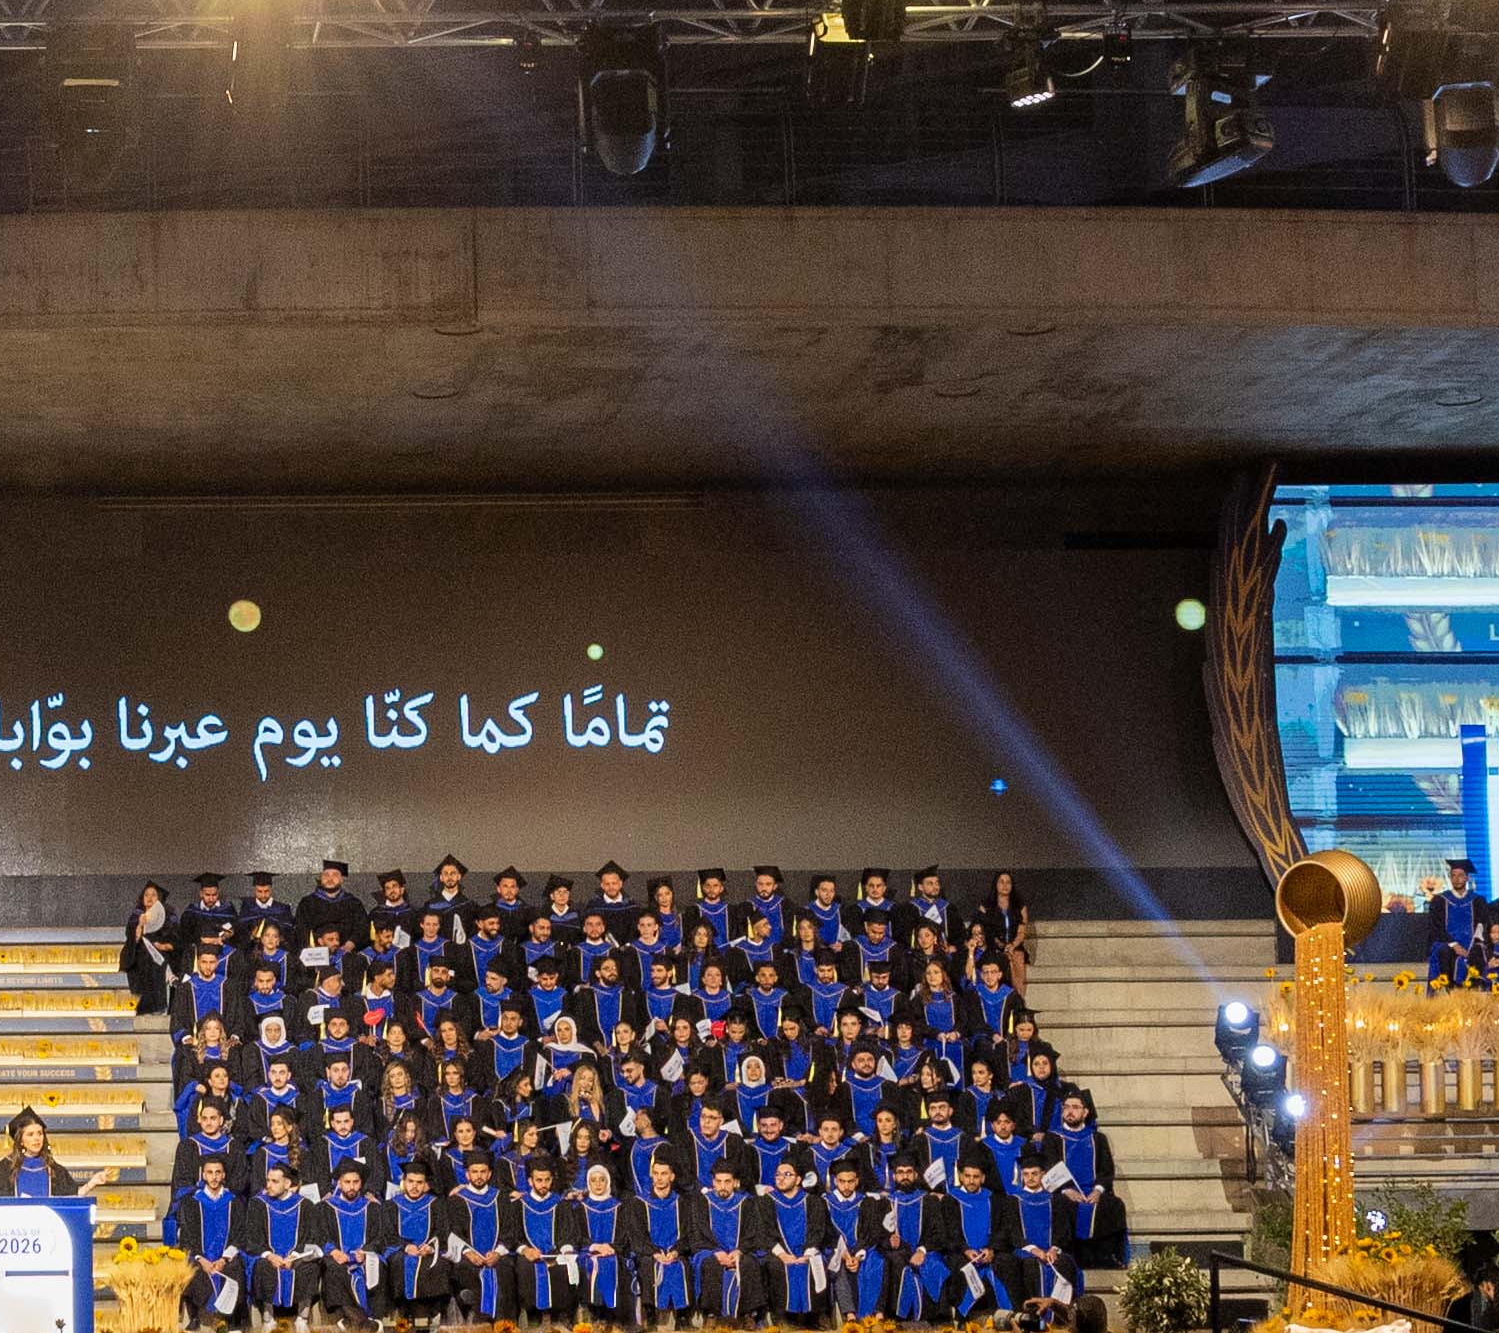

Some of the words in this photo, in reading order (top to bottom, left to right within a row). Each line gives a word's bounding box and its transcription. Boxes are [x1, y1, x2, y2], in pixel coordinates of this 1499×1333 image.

[119, 697, 228, 769] عبرنا
[253, 717, 342, 782] يوم
[365, 688, 434, 748] كنّا
[460, 691, 539, 754] كما
[563, 684, 670, 753] تمامًا
[40, 1069, 76, 1078] SUCCESS
[0, 1238, 41, 1254] 2026
